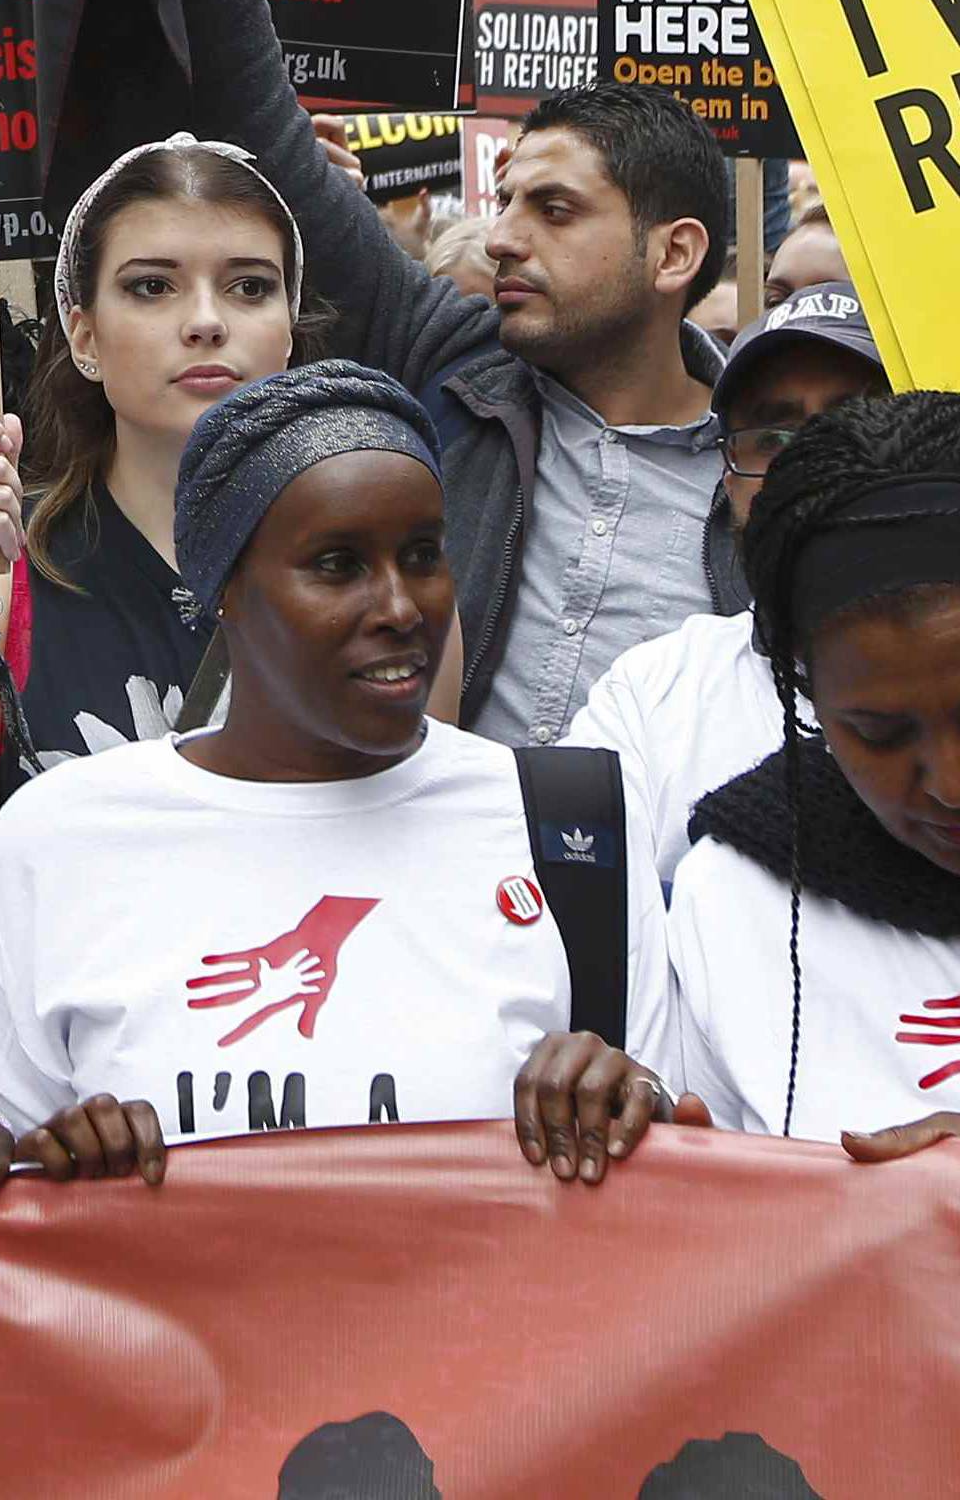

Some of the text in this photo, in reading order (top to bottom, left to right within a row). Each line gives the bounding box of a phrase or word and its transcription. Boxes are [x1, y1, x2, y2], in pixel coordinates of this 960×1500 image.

[614, 5, 750, 55] HERE
[614, 55, 691, 85] Open
[701, 58, 744, 87] the
[742, 93, 769, 121] in
